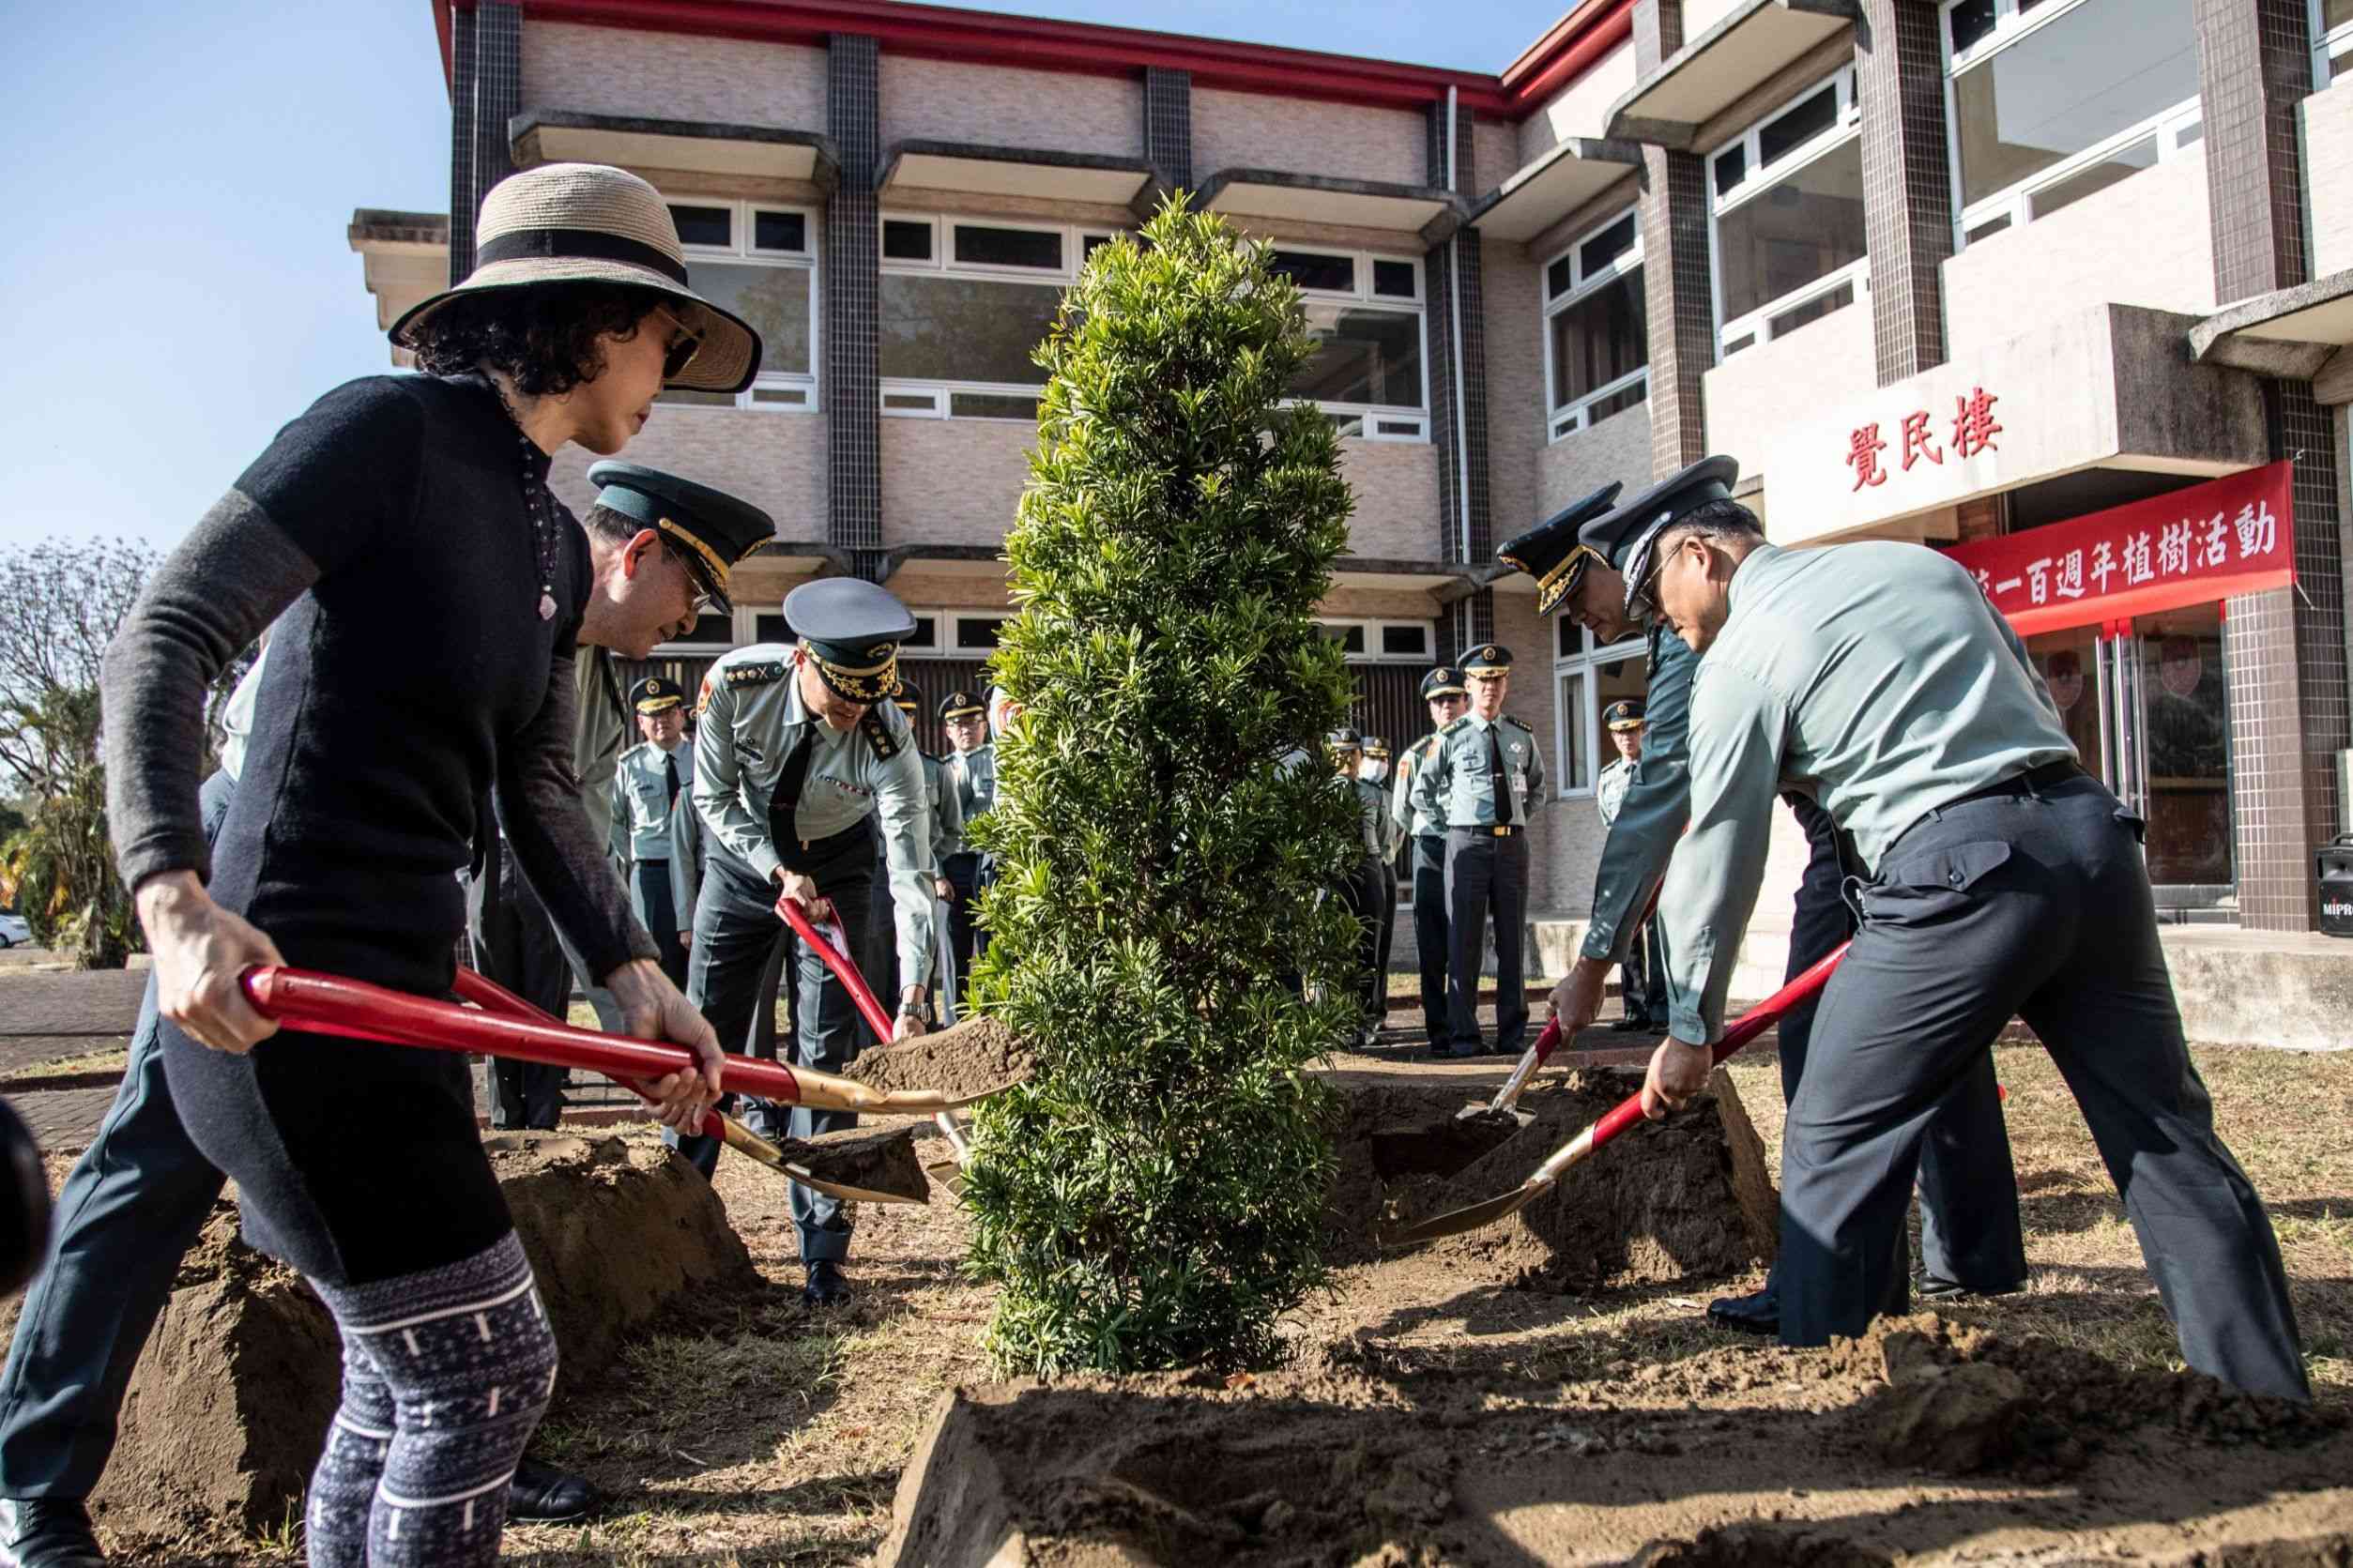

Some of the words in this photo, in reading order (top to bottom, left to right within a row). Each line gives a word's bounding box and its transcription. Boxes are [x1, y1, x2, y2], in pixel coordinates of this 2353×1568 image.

[1846, 387, 2003, 493] 覺民樓
[2323, 903, 2353, 917] MIPR
